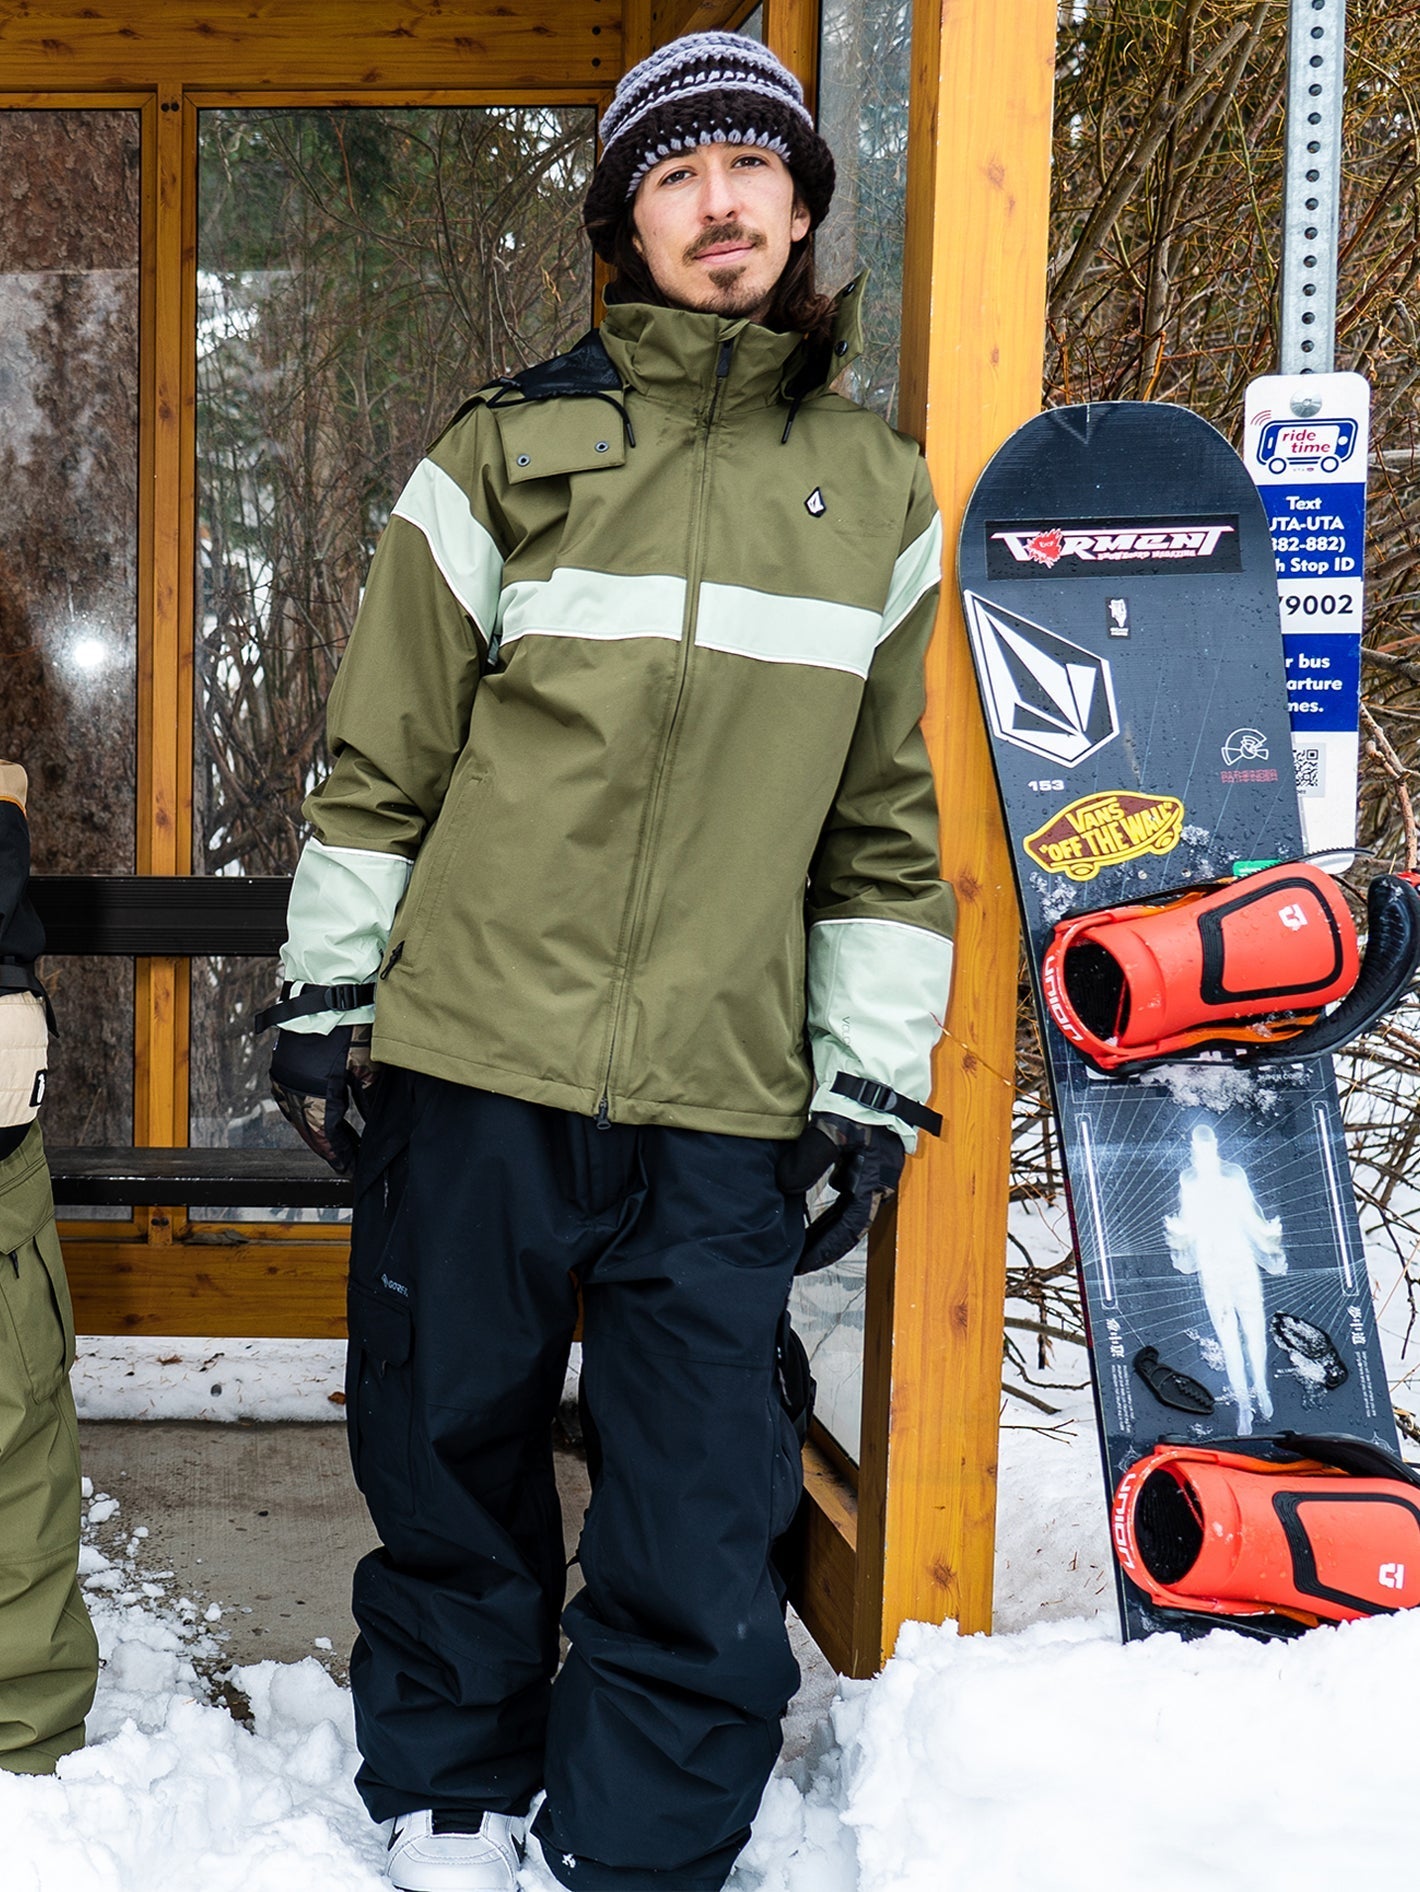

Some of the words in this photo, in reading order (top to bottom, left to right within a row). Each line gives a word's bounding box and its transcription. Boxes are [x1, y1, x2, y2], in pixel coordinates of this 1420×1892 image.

[1282, 429, 1316, 442] ride
[1291, 442, 1331, 454] time
[1285, 496, 1322, 510] Text
[1290, 557, 1329, 575] Stop
[1334, 557, 1355, 572] ID
[1298, 653, 1331, 668] bus
[1286, 678, 1343, 690] arture
[1287, 701, 1324, 712] mes.
[1028, 779, 1065, 792] 153
[1064, 796, 1126, 834] VANS
[1082, 821, 1130, 856] THE
